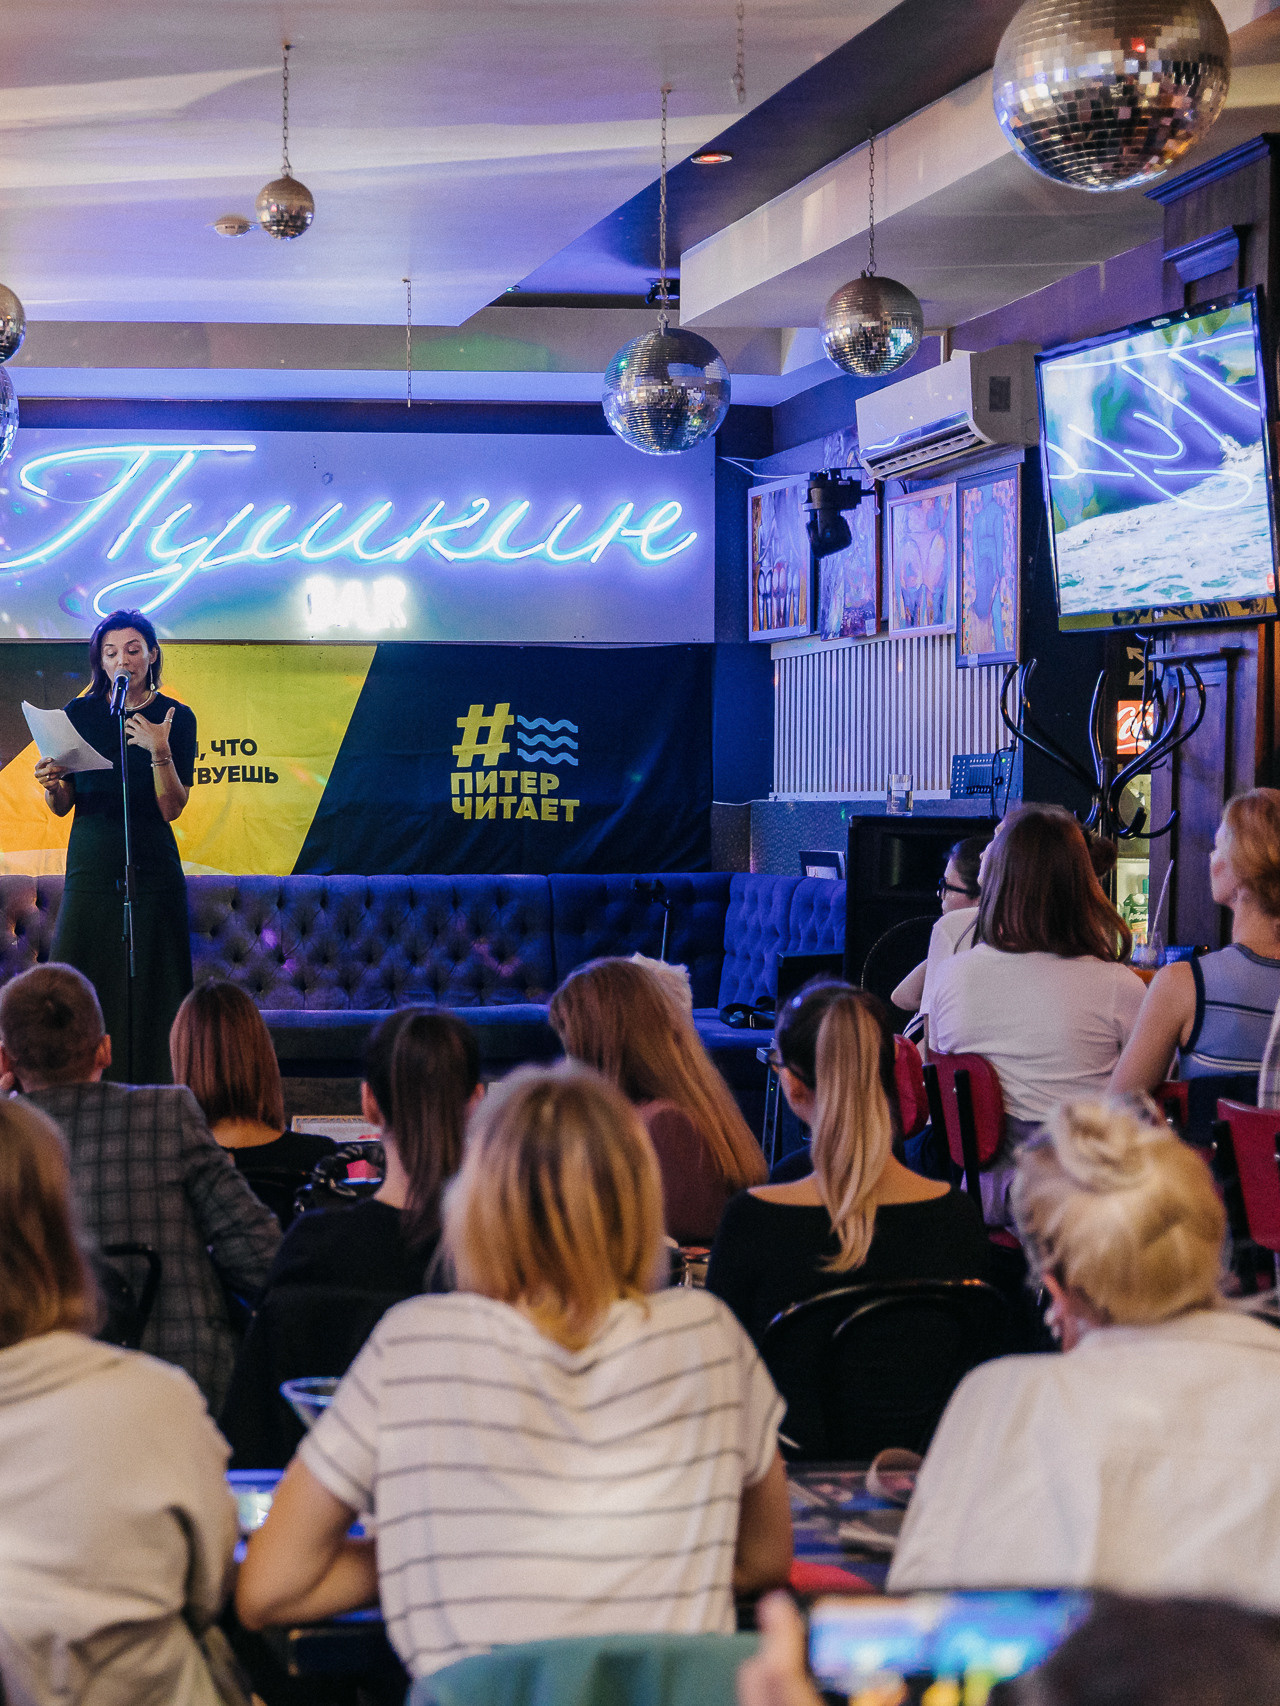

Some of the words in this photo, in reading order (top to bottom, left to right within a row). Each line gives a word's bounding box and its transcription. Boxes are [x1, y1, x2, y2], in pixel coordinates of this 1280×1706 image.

[210, 738, 258, 757] ЧТО
[194, 765, 279, 785] ВУЕШЬ
[450, 770, 560, 795] ПИТЕР
[451, 795, 580, 822] ЧИТАЕТ
